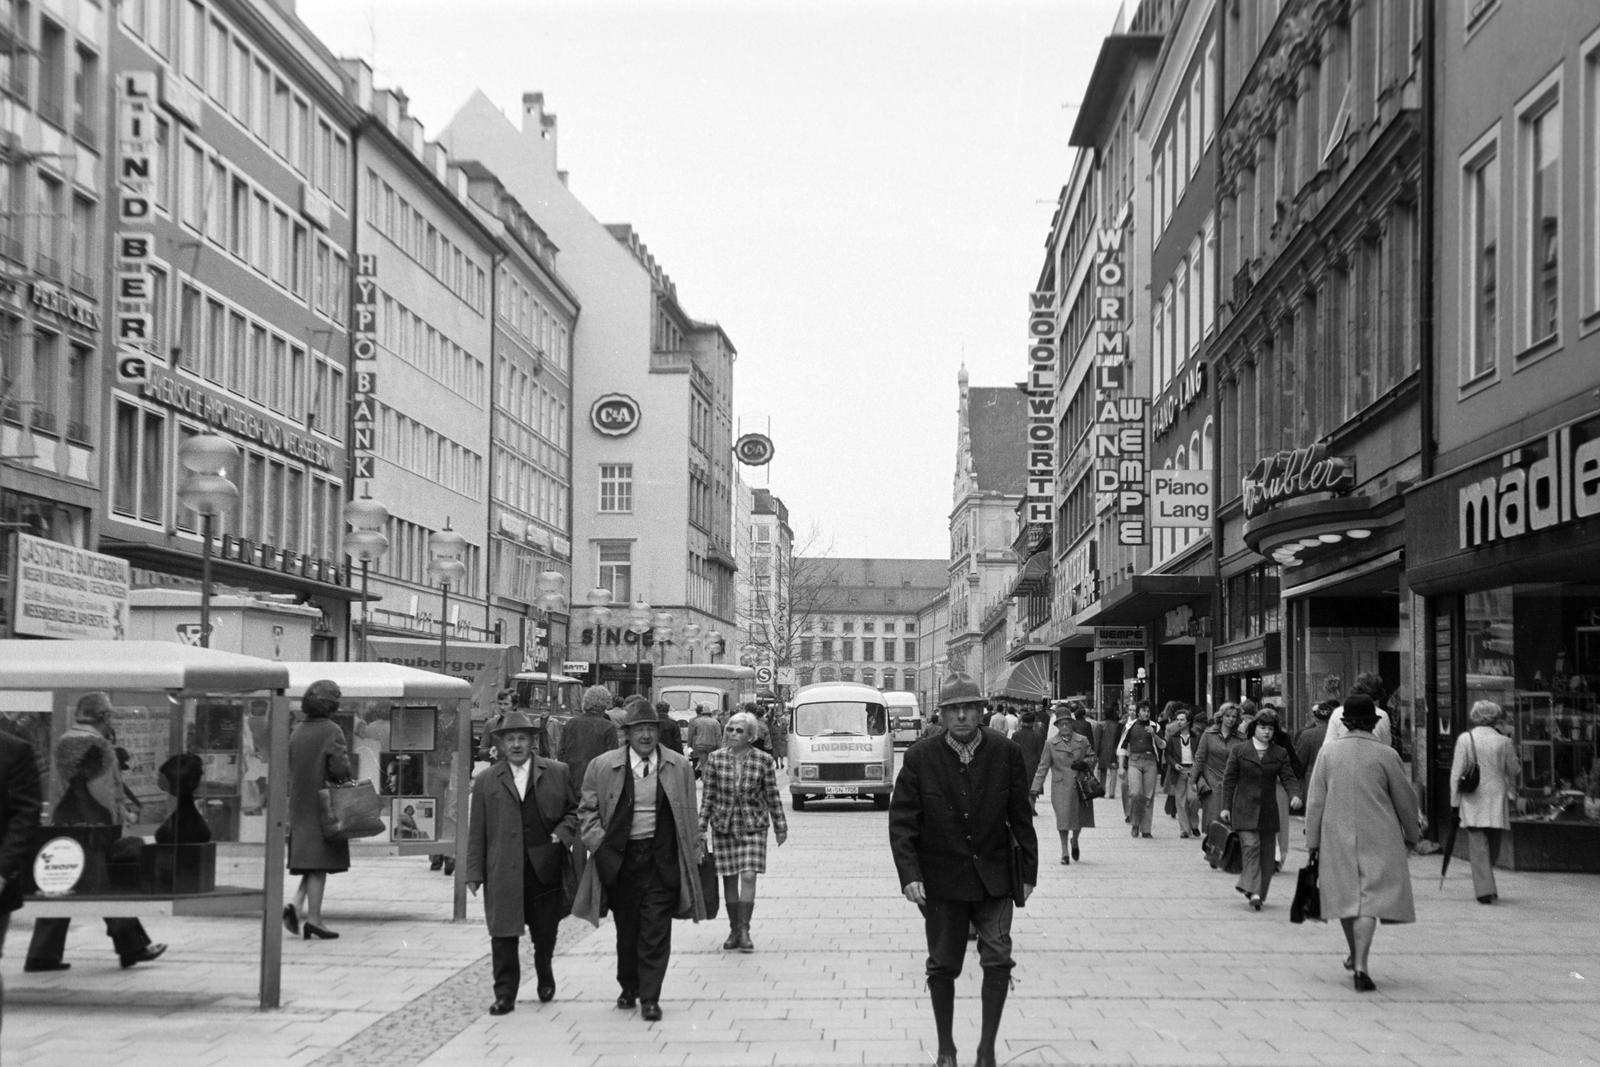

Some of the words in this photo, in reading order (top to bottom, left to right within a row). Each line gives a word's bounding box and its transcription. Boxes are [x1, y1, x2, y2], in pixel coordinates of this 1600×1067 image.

[122, 76, 150, 378] LINDBERG
[1098, 229, 1123, 492] WORMLAND
[600, 406, 632, 423] C&A
[1030, 293, 1056, 521] WOOLWORTH
[1119, 398, 1144, 544] WEMPE
[1155, 478, 1209, 495] Piano
[1160, 501, 1209, 521] Lang
[1100, 630, 1143, 639] WEMPE
[811, 743, 873, 752] LINDBERG
